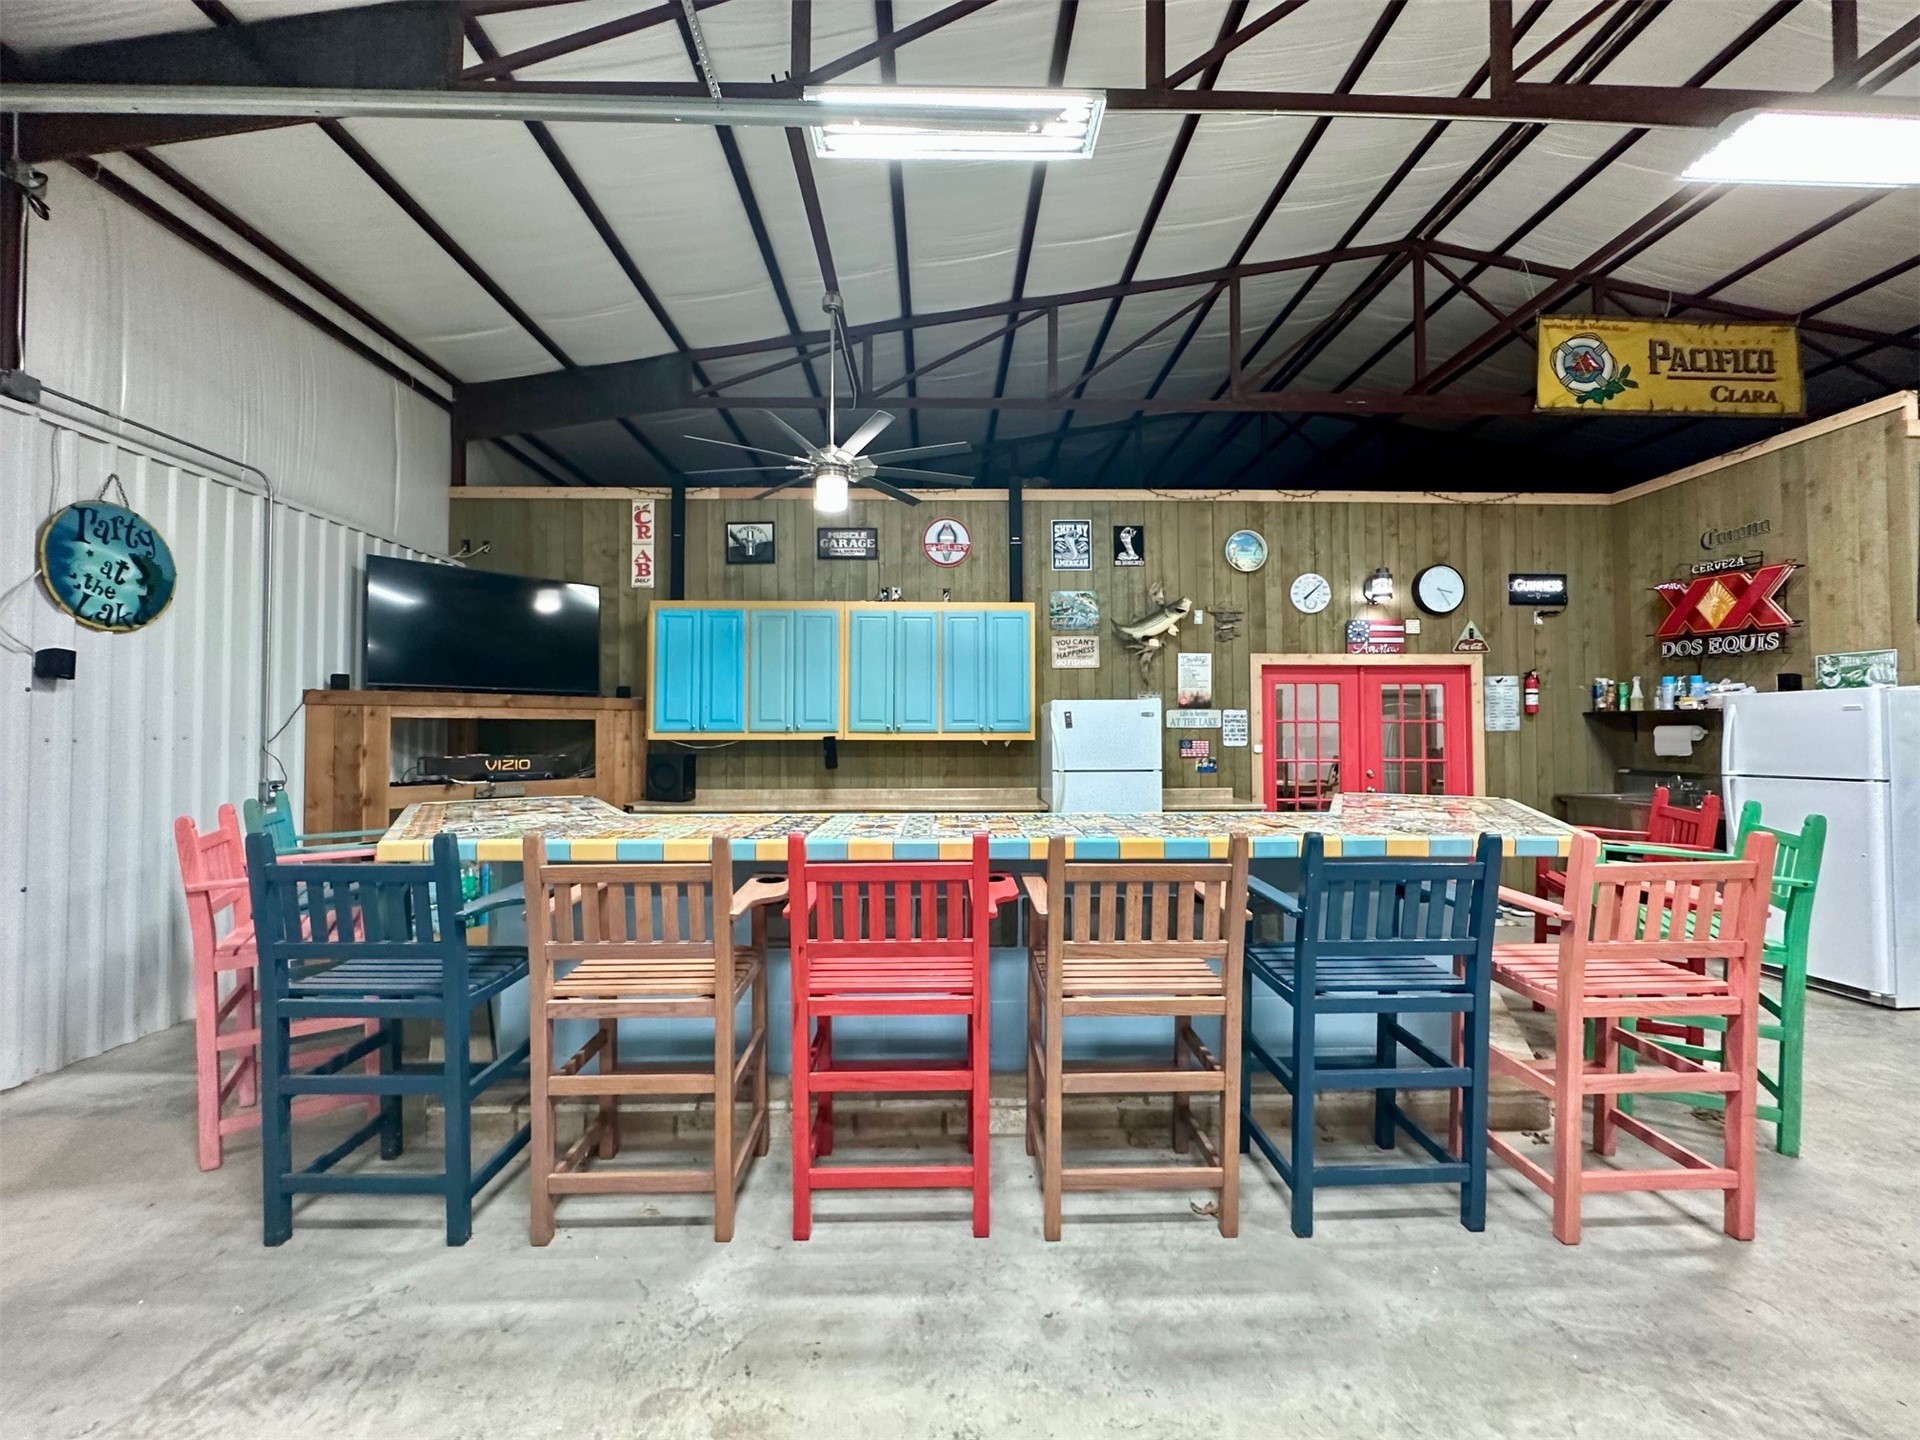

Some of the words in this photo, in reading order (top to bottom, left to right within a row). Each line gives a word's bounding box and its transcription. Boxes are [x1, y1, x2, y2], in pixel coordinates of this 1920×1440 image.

[820, 539, 875, 548] GARAGE
[100, 559, 130, 586] at
[1692, 557, 1744, 574] CERVEZA
[83, 573, 117, 600] the
[1662, 639, 1703, 658] DOS
[1708, 633, 1780, 654] EQUIS
[1057, 647, 1095, 659] HAPPINESS
[1170, 718, 1181, 726] AT
[1182, 718, 1197, 726] THE
[1199, 718, 1217, 726] LAKE
[485, 759, 531, 771] VIZIO
